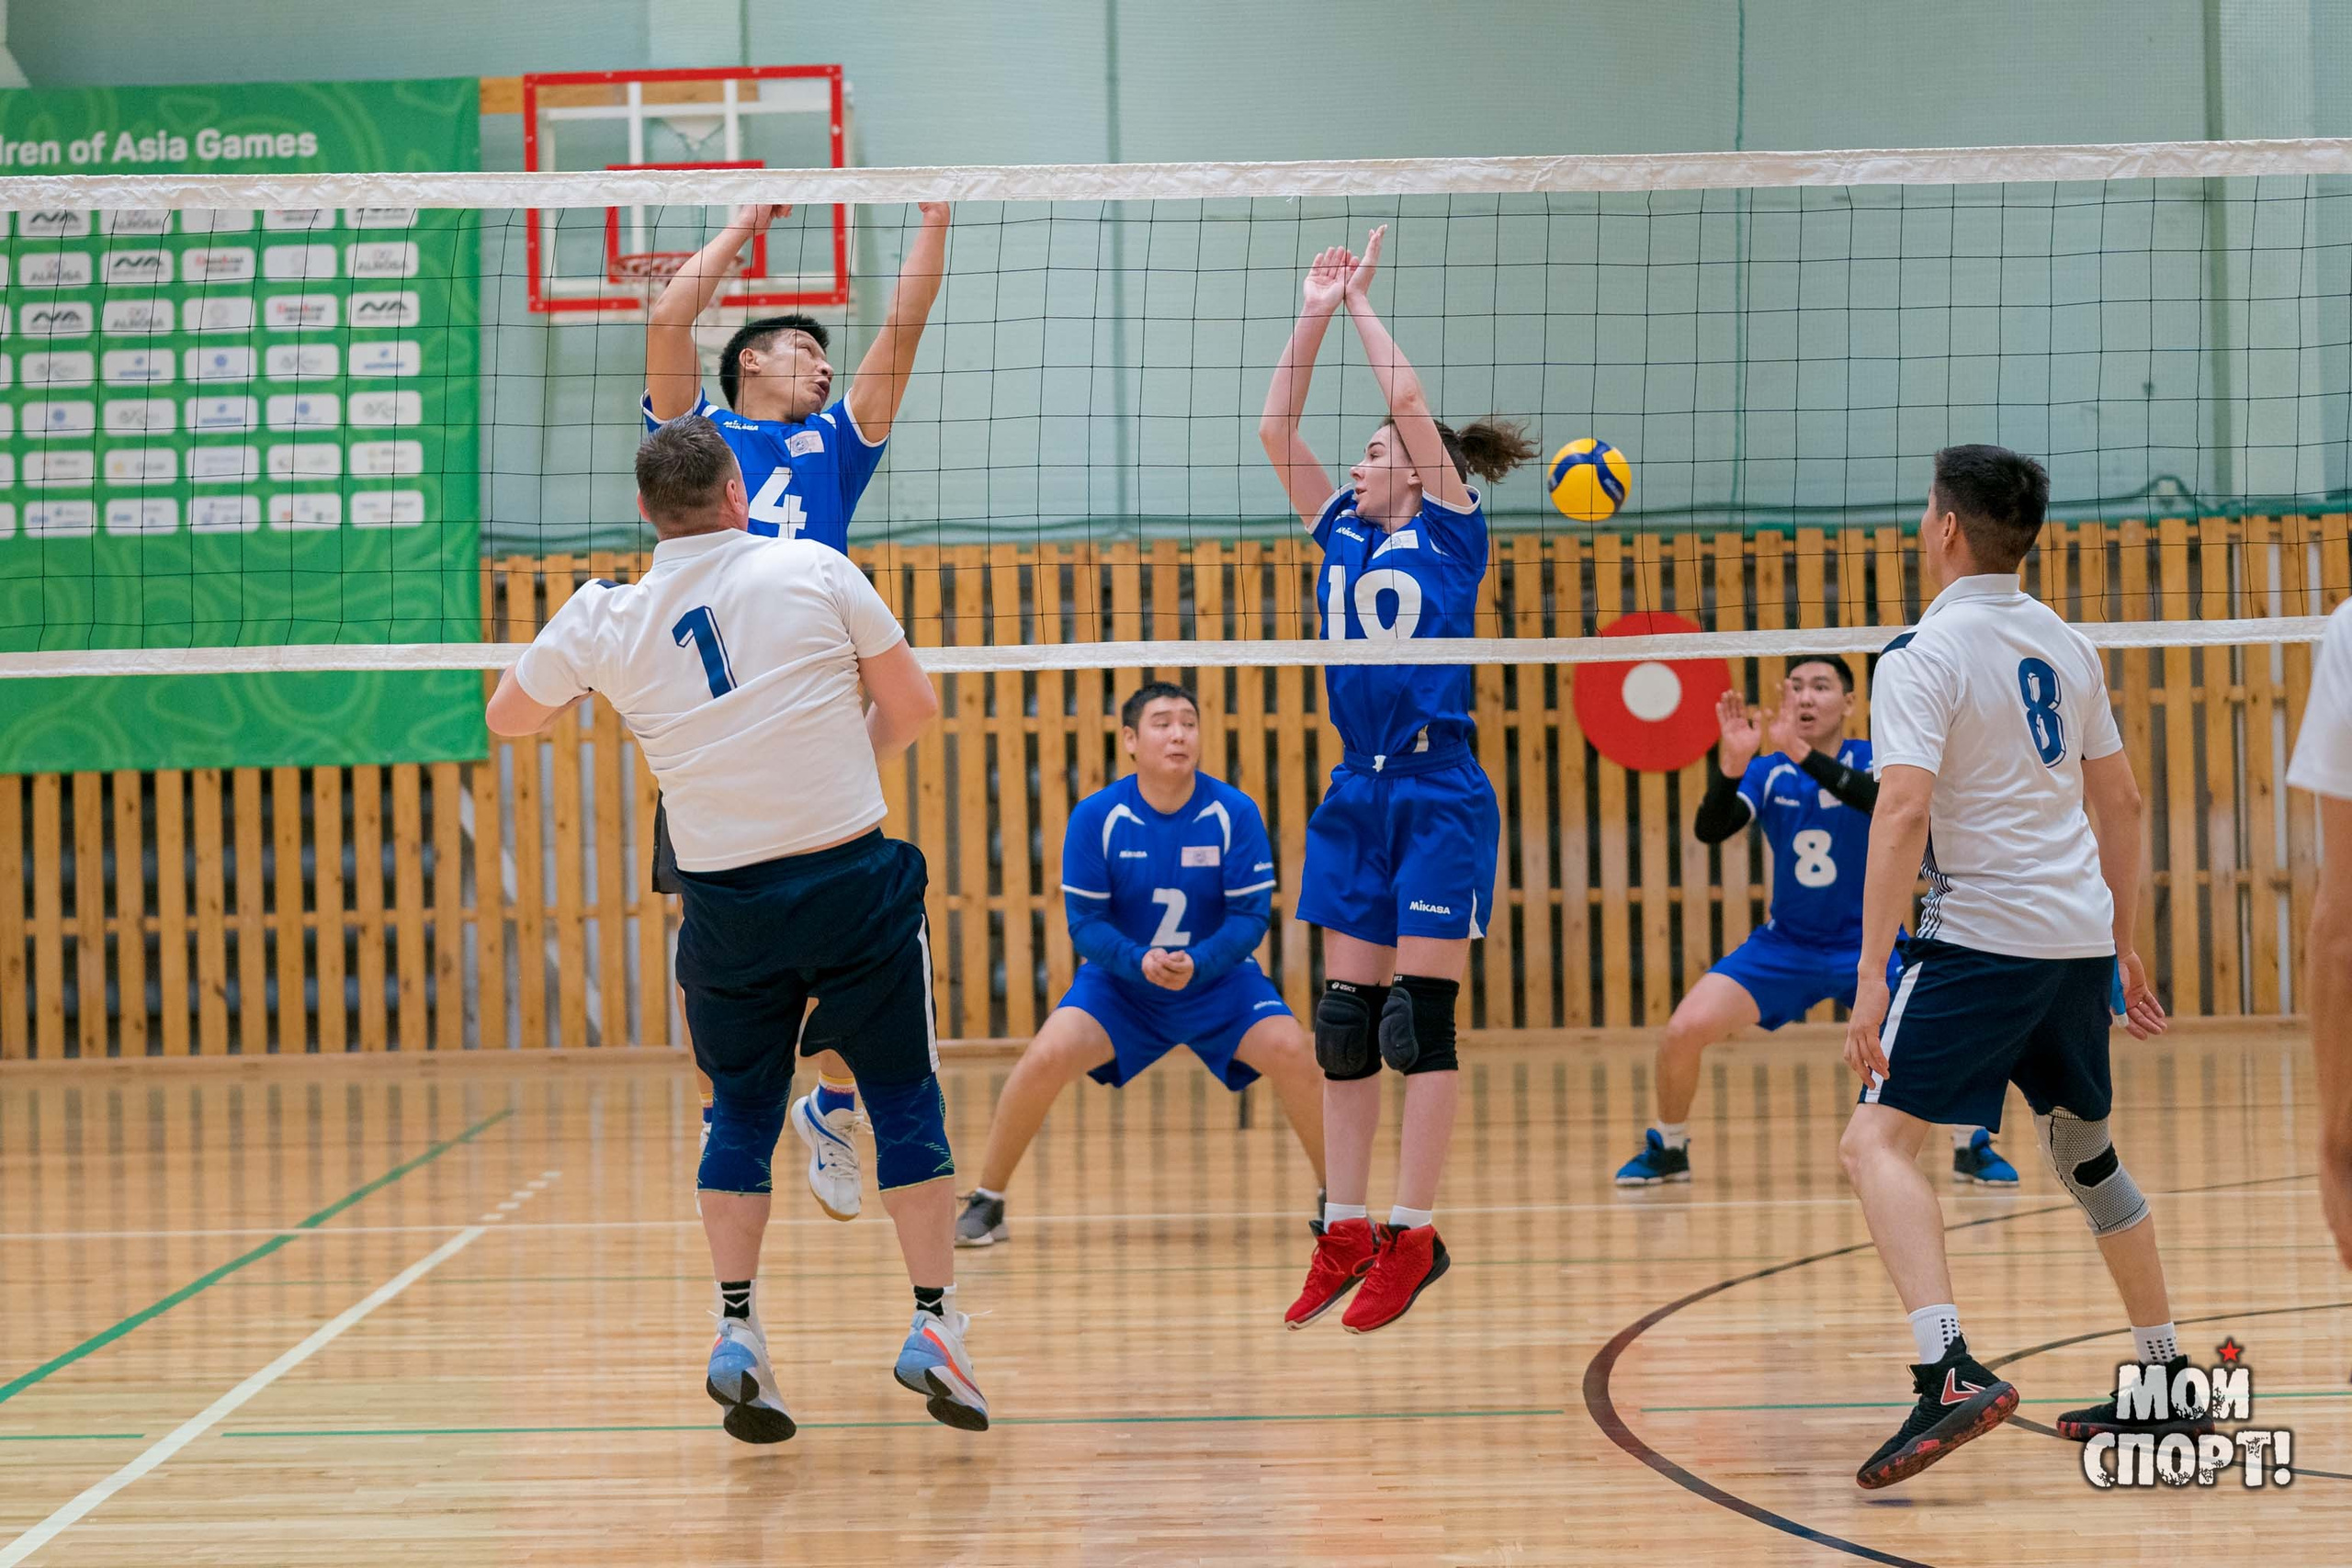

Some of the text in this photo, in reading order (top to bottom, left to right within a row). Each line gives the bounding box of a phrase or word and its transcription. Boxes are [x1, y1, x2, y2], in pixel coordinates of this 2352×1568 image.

[69, 130, 107, 163] of
[111, 130, 187, 163] Asia
[196, 129, 318, 160] Games
[749, 467, 808, 539] 4
[1328, 565, 1422, 639] 10
[672, 605, 738, 698] 1
[2018, 657, 2066, 768] 8
[1792, 829, 1838, 887] 8
[1150, 888, 1192, 947] 2
